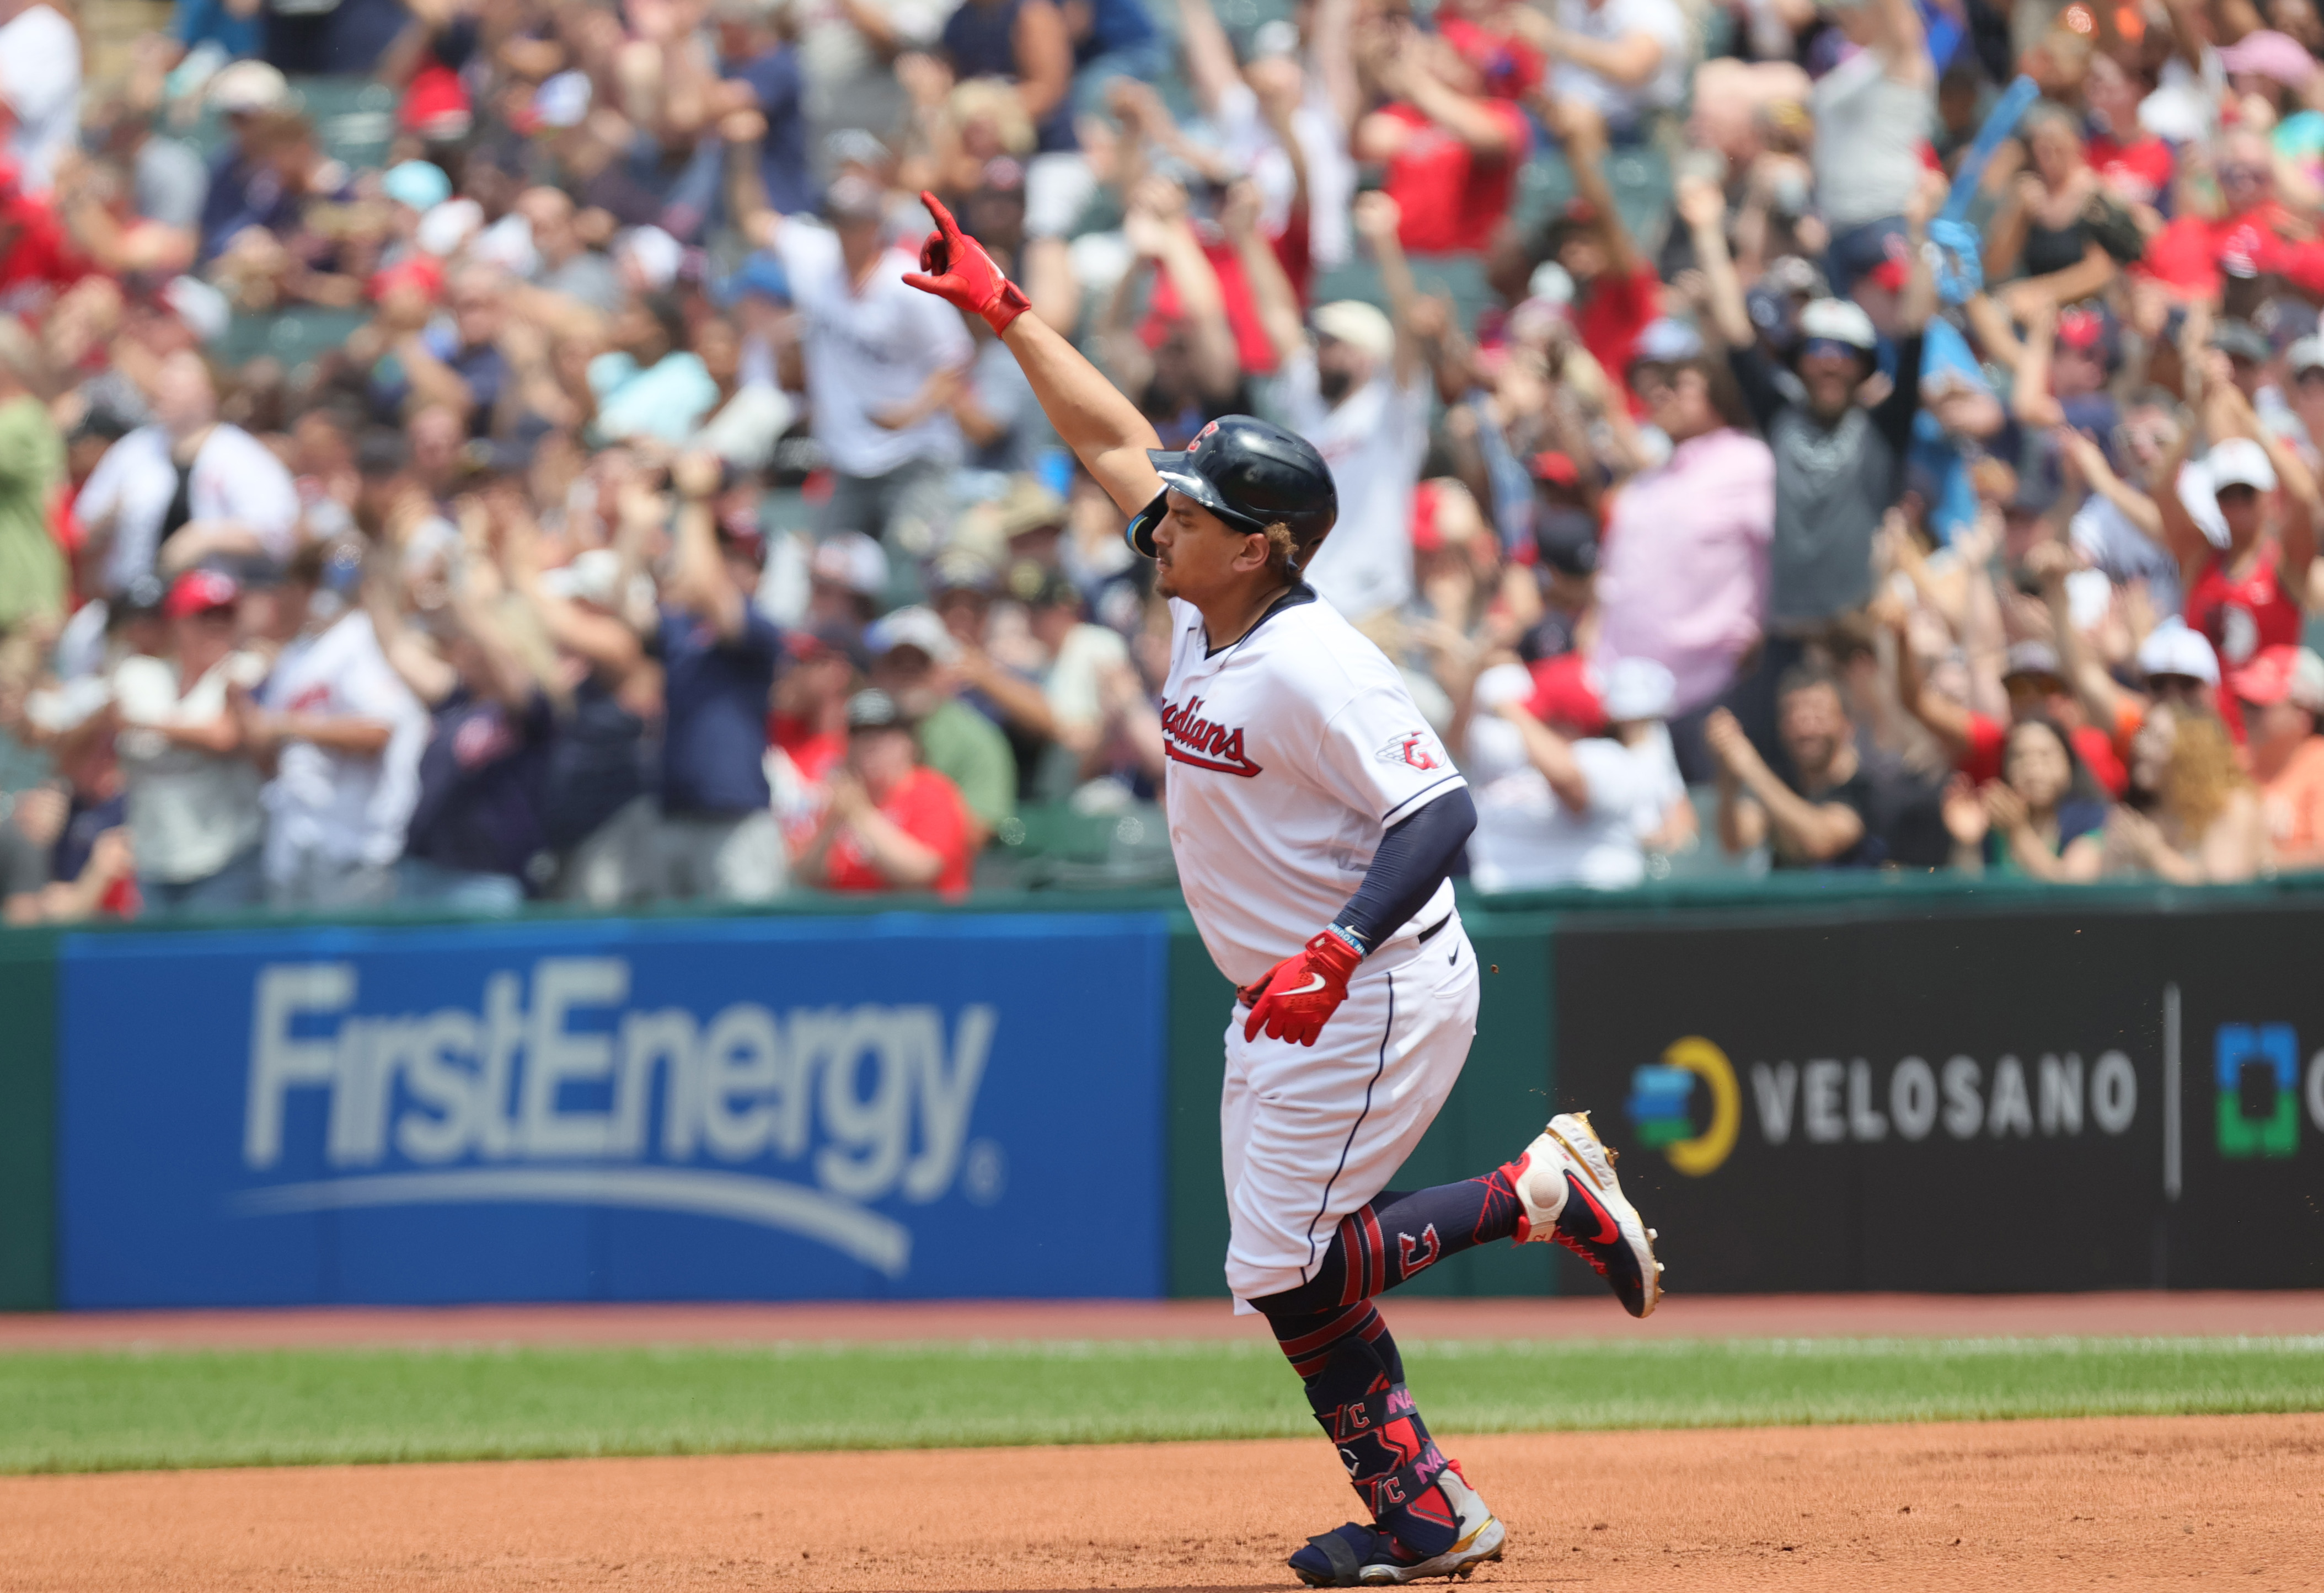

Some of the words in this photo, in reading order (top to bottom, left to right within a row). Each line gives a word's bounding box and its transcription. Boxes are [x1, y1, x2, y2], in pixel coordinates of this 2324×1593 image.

[1750, 1049, 2139, 1145] VELOSANO
[1348, 1402, 1370, 1428] C
[1383, 1476, 1406, 1503] C
